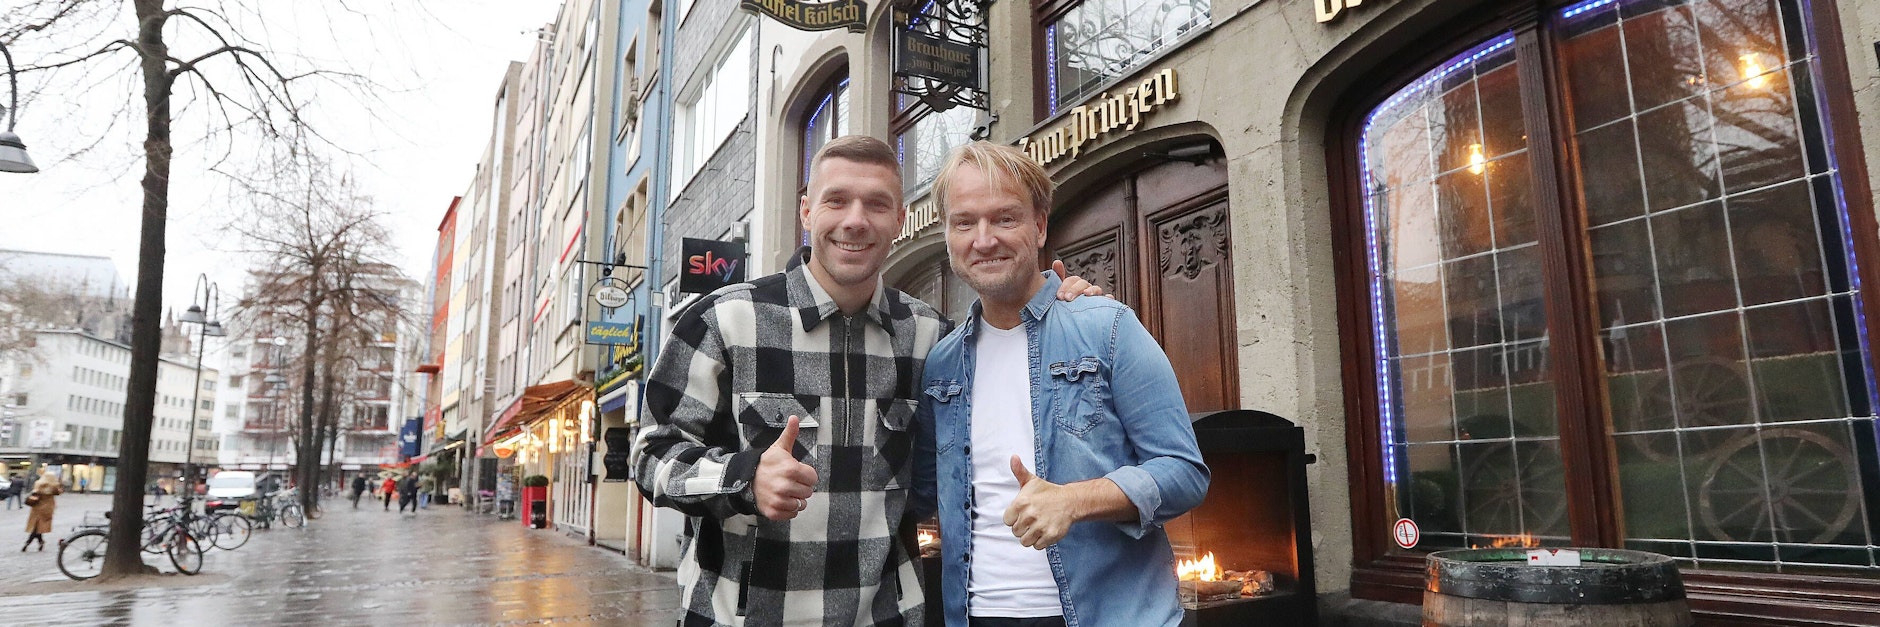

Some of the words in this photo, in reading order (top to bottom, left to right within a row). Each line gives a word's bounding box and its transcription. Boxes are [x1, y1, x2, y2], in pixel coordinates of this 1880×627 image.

[907, 36, 971, 65] Brauhaus
[1070, 68, 1177, 159] Prinzen
[689, 251, 738, 282] sky
[591, 326, 629, 340] täglich
